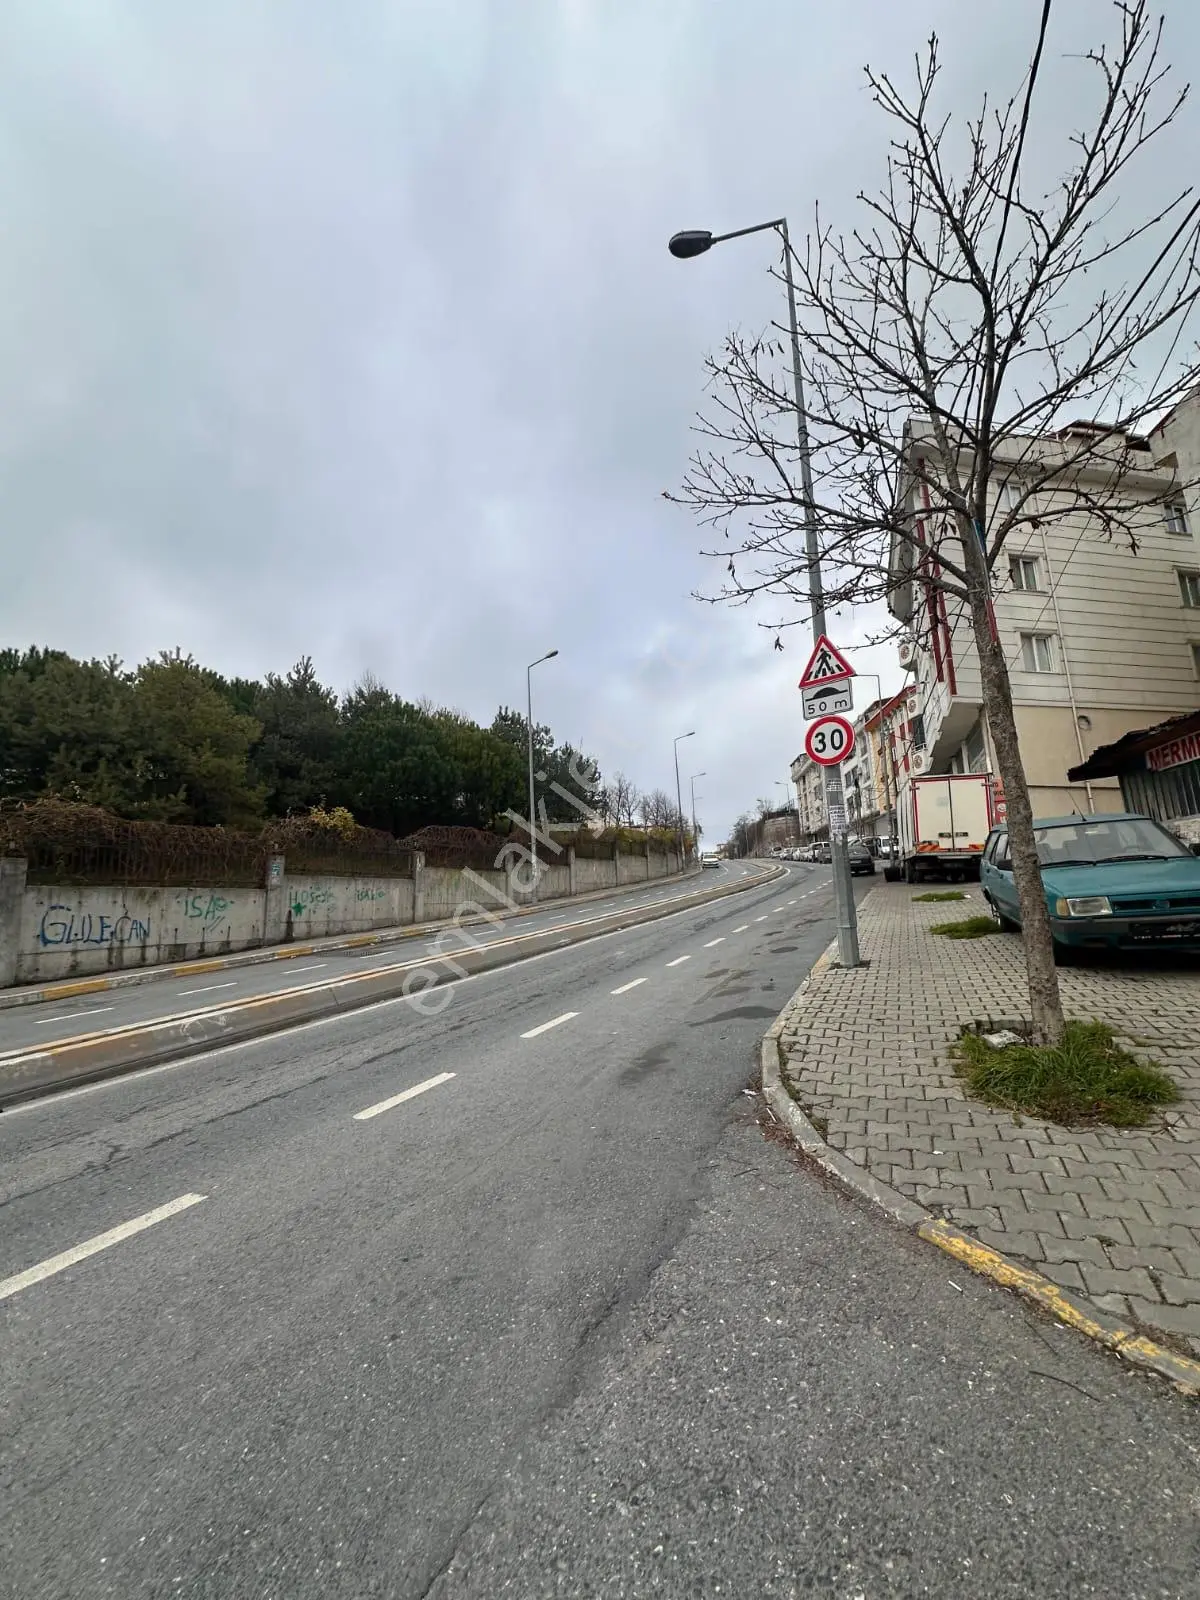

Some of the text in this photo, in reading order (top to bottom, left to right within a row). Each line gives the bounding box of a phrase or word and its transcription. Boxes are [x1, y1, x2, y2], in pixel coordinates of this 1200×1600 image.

[807, 698, 848, 716] 50 m
[814, 728, 844, 754] 30
